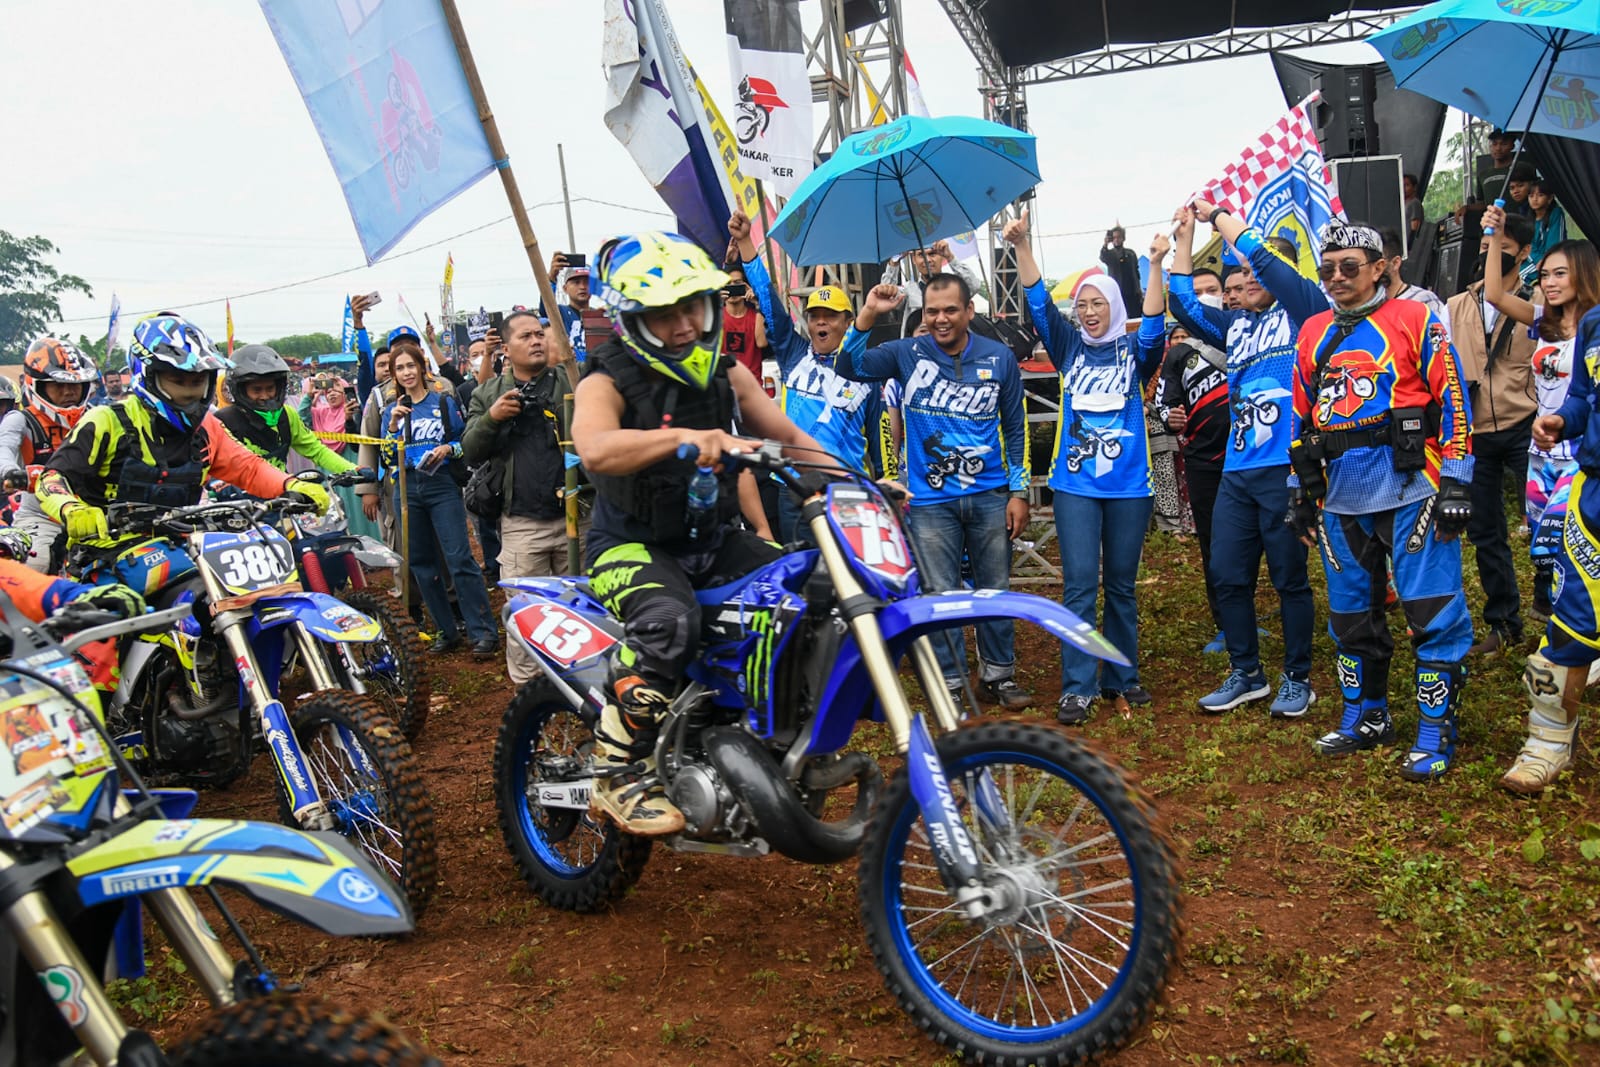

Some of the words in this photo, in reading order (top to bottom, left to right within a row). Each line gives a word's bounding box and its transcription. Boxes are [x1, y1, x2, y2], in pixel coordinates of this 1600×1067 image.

[771, 165, 794, 179] KER
[1258, 187, 1292, 226] IKATAN
[856, 505, 906, 567] 13
[143, 549, 166, 566] FOX
[220, 544, 290, 587] 388
[530, 605, 592, 659] 13
[1338, 654, 1358, 669] FOX
[1419, 672, 1440, 683] FOX
[922, 752, 978, 865] DUNLOP
[101, 865, 182, 896] PIRELLI
